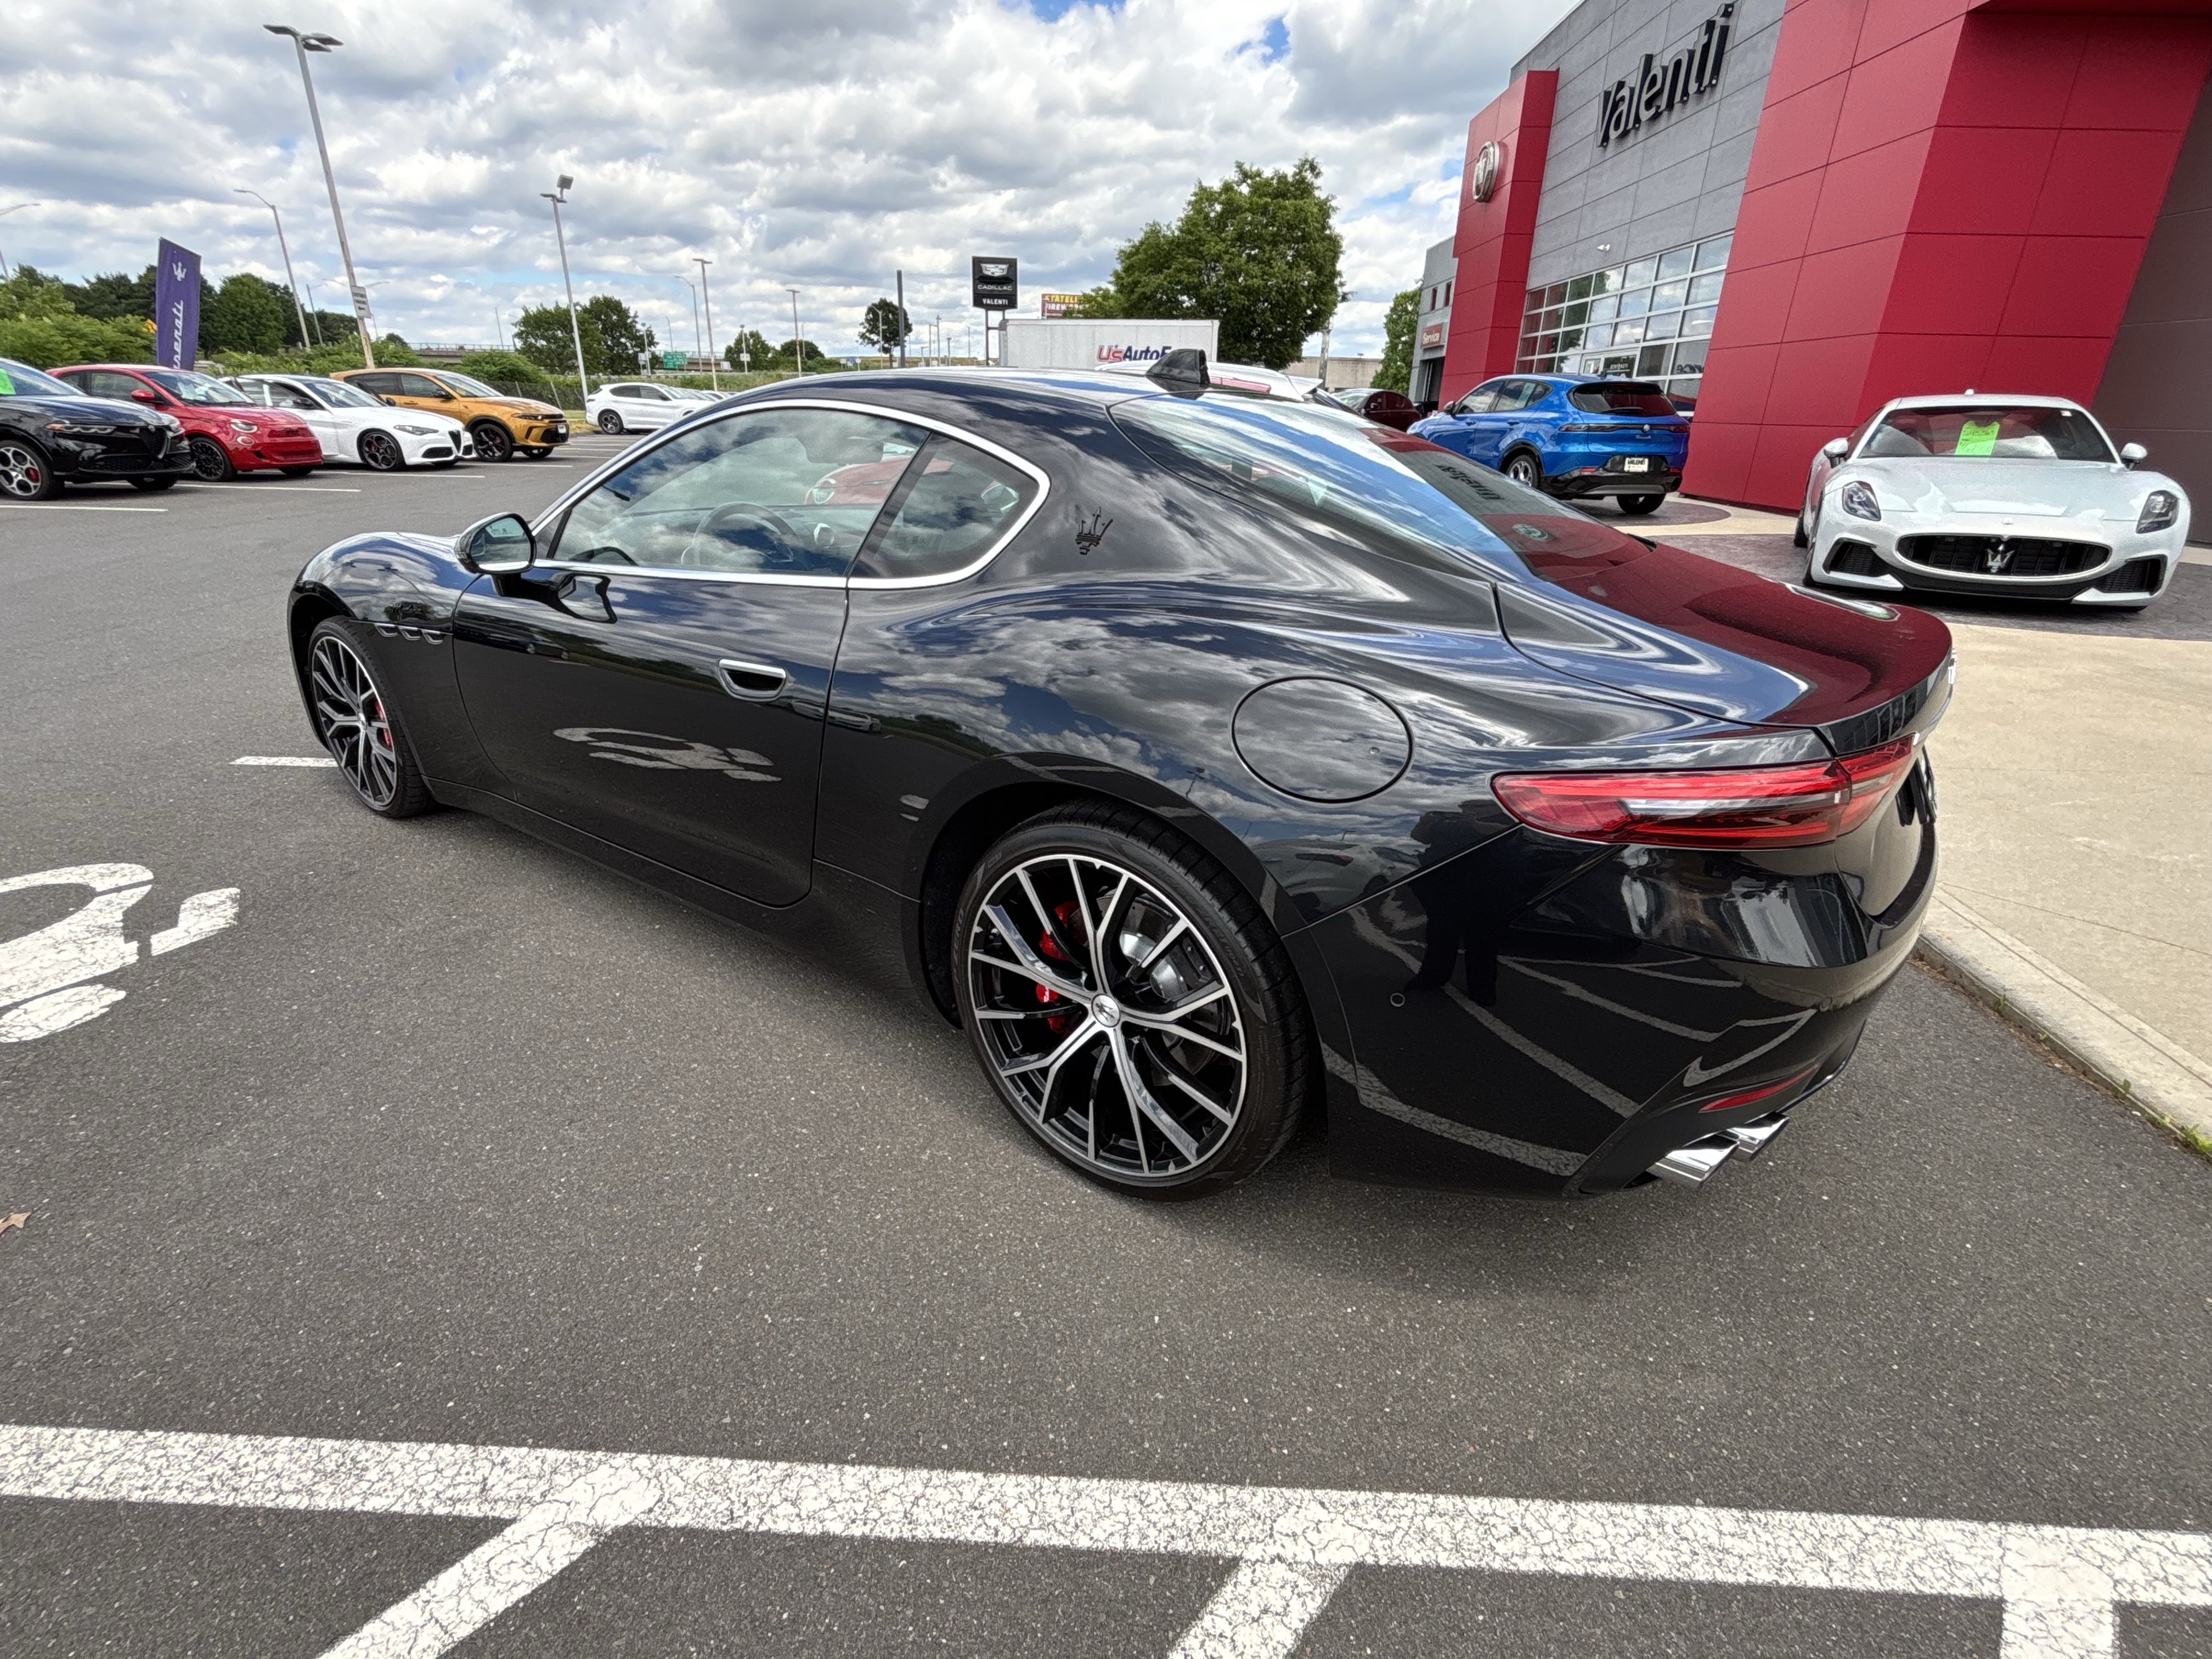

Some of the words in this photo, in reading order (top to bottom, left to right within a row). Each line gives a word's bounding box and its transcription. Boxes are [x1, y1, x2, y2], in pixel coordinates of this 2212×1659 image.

[1596, 3, 1735, 148] Valenti
[172, 300, 184, 369] serati
[1423, 330, 1440, 344] Service
